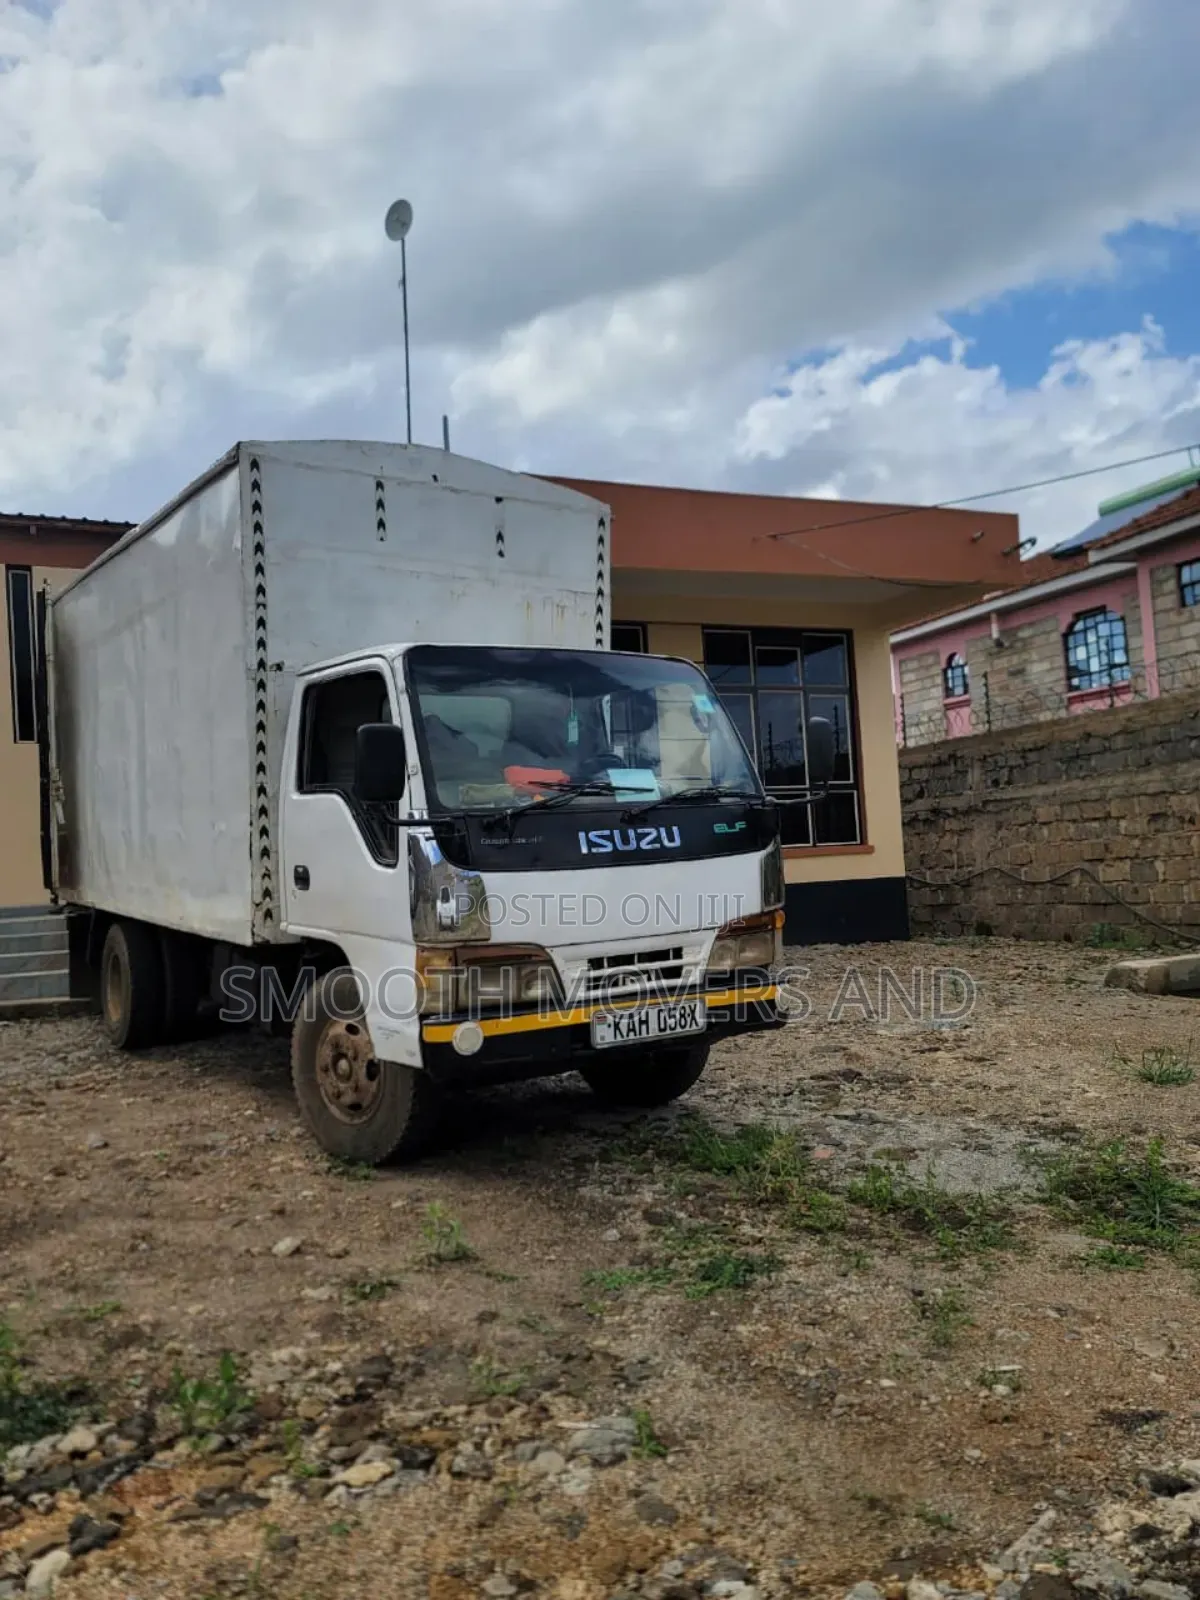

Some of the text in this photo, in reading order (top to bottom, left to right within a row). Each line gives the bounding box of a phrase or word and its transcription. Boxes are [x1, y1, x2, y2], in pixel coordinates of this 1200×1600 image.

[578, 825, 681, 854] ISUZU
[713, 821, 747, 834] ELF
[613, 1010, 650, 1040] KAH
